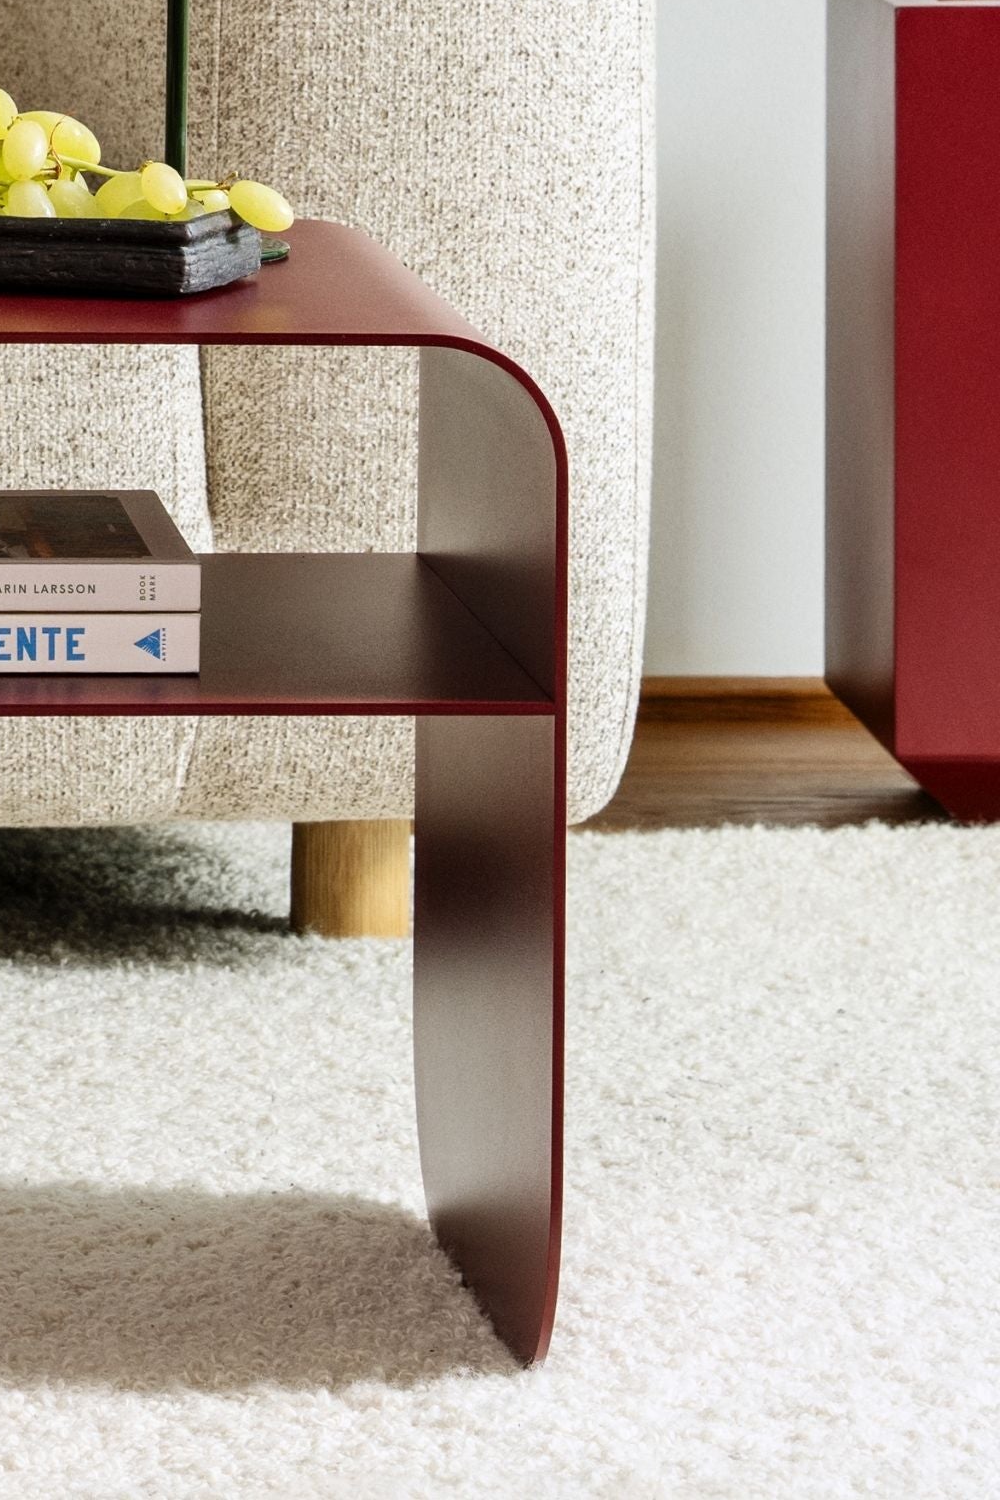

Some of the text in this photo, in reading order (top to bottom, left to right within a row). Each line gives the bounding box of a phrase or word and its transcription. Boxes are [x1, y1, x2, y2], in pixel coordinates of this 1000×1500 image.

[33, 583, 96, 595] LARSSON
[138, 574, 147, 602] BOOK
[148, 574, 157, 602] MARK
